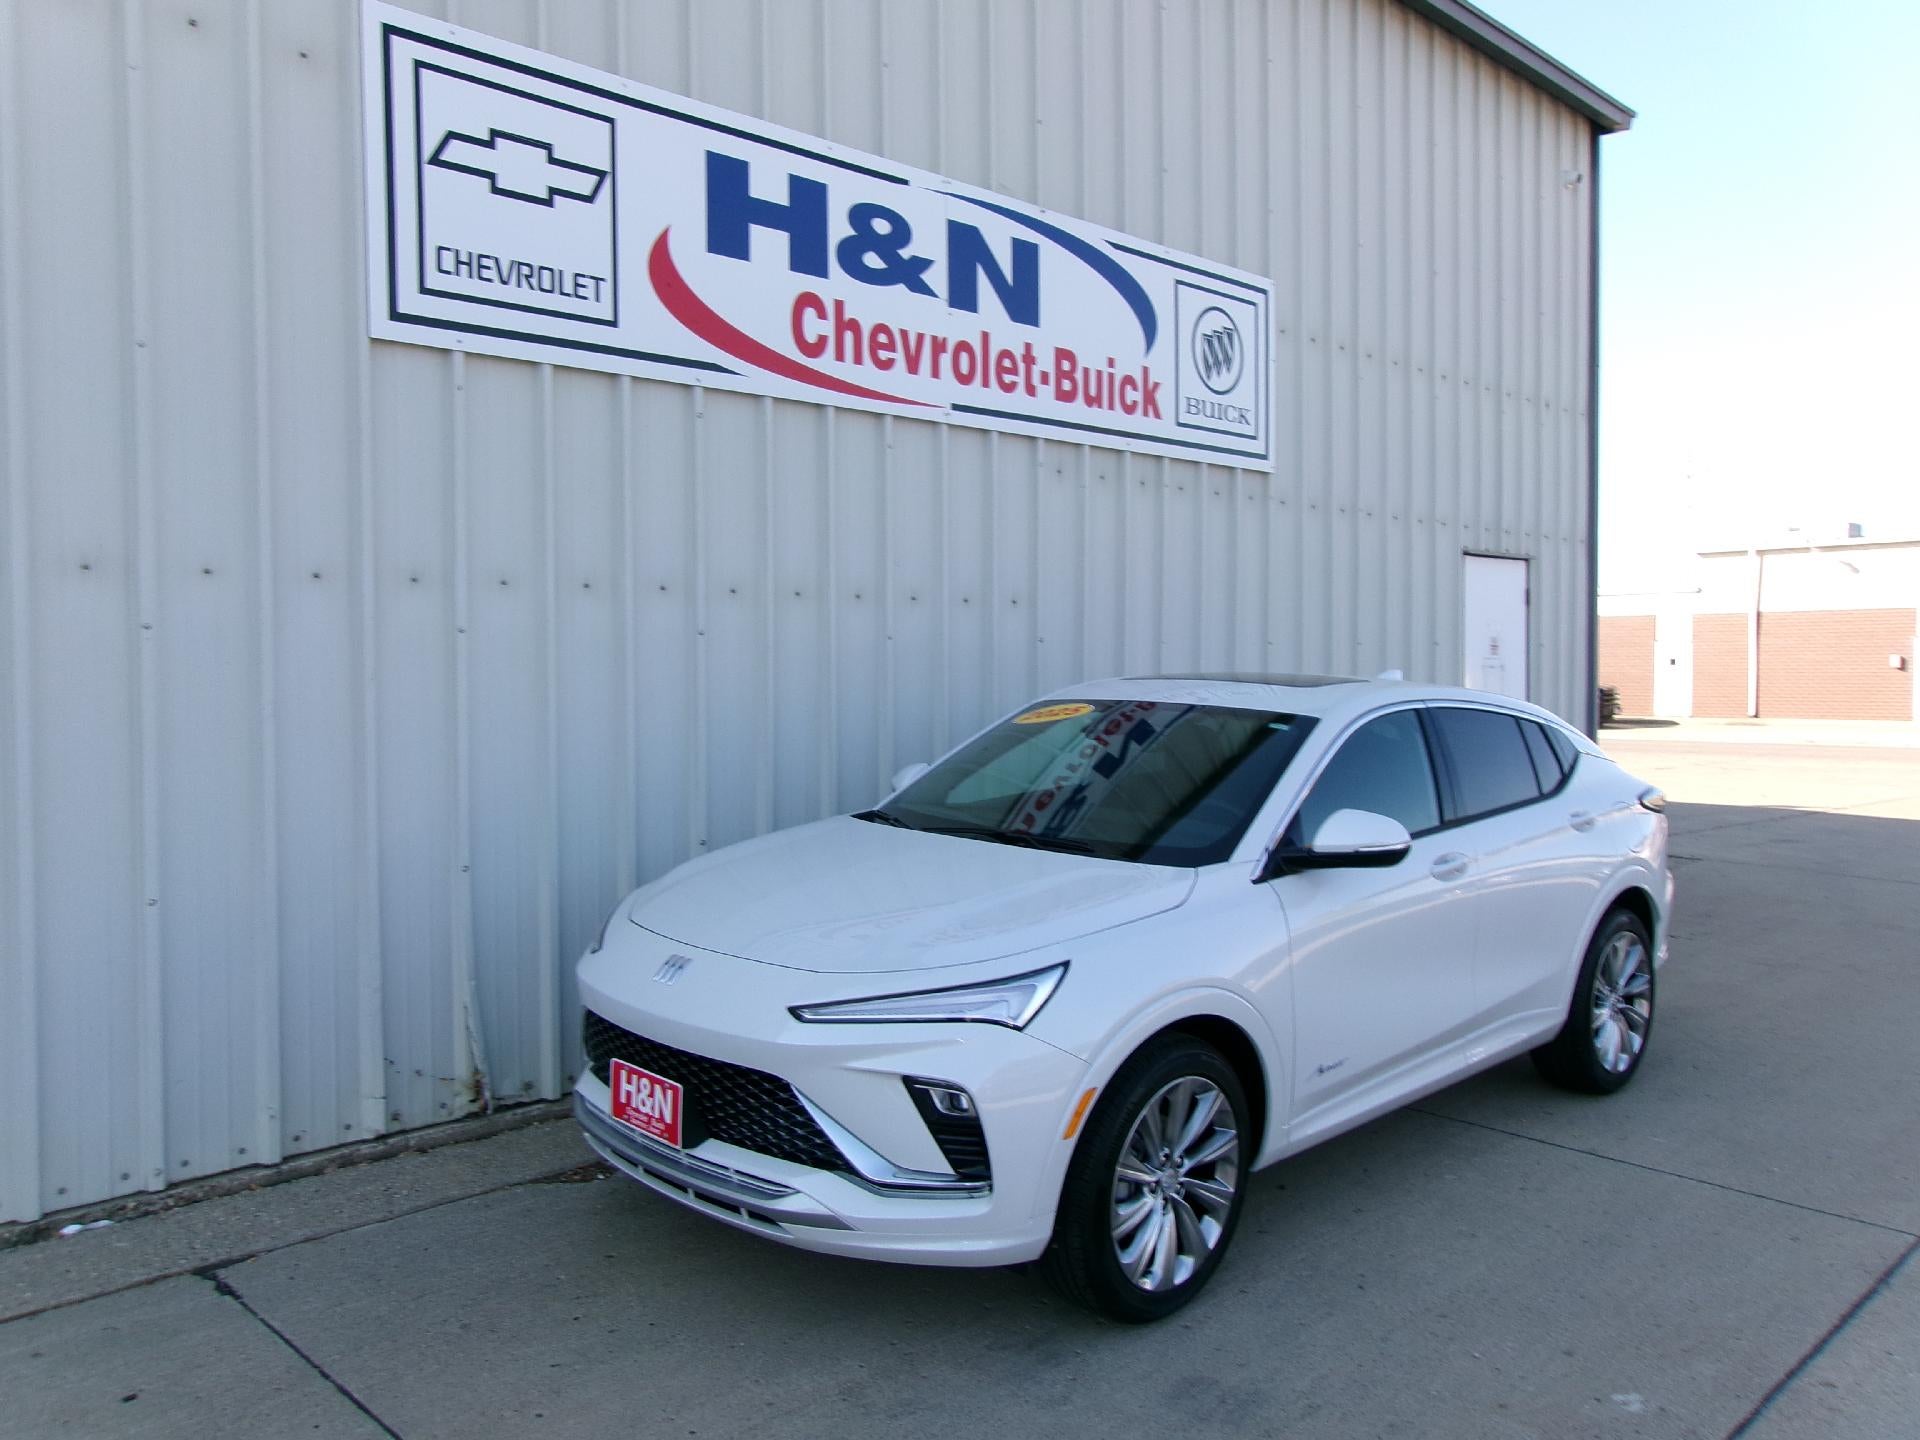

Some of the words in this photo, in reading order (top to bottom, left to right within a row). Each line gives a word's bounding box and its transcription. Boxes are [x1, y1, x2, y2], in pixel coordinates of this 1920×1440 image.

[706, 149, 1040, 328] H&N
[436, 245, 606, 304] CHEVROLET
[1184, 397, 1252, 426] BUICK
[619, 1069, 673, 1125] H&N
